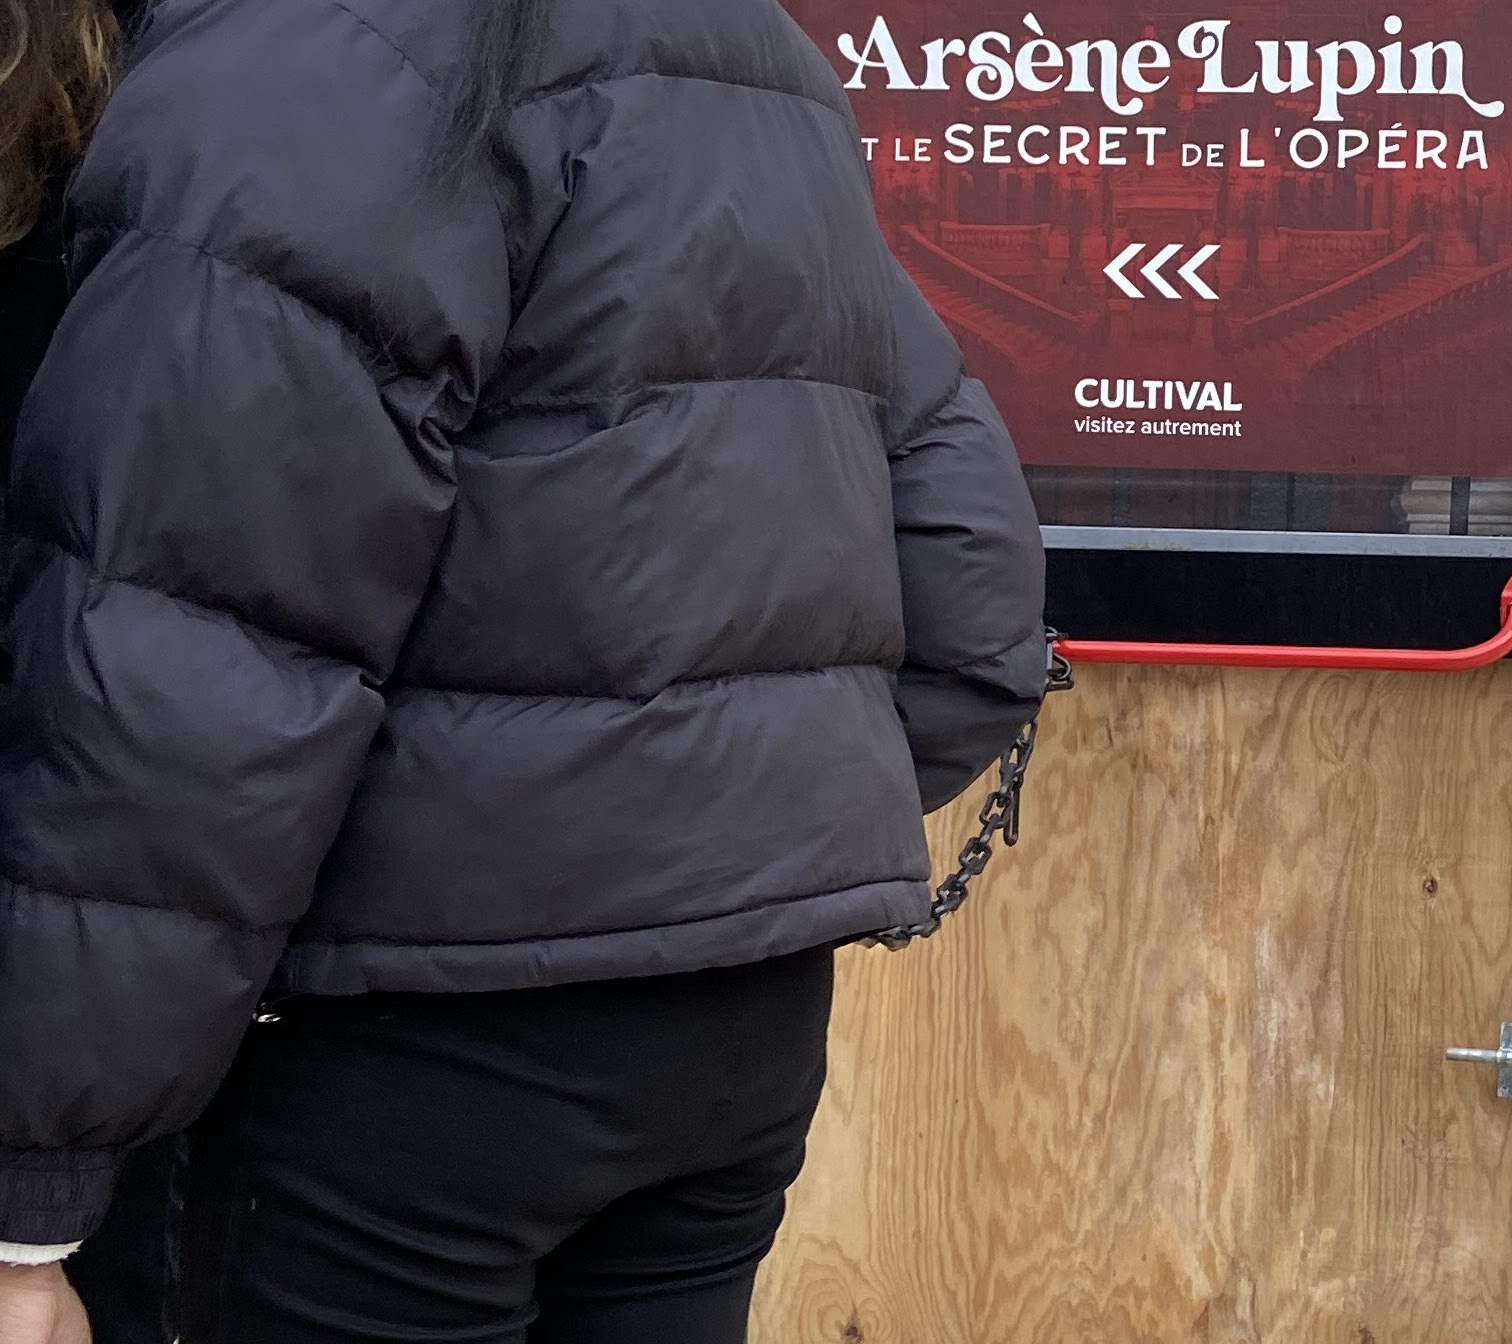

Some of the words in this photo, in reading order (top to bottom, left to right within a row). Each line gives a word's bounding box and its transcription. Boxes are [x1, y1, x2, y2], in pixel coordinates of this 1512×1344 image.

[837, 12, 1171, 116] Arsène
[1177, 15, 1505, 122] Lupin
[894, 137, 932, 162] LE
[943, 123, 1167, 166] SECRET
[1181, 143, 1225, 167] DE
[1239, 122, 1489, 170] L'OPÉRA
[1074, 378, 1243, 412] CULTIVAL
[1073, 415, 1136, 434] visitez
[1140, 417, 1242, 437] autrement
